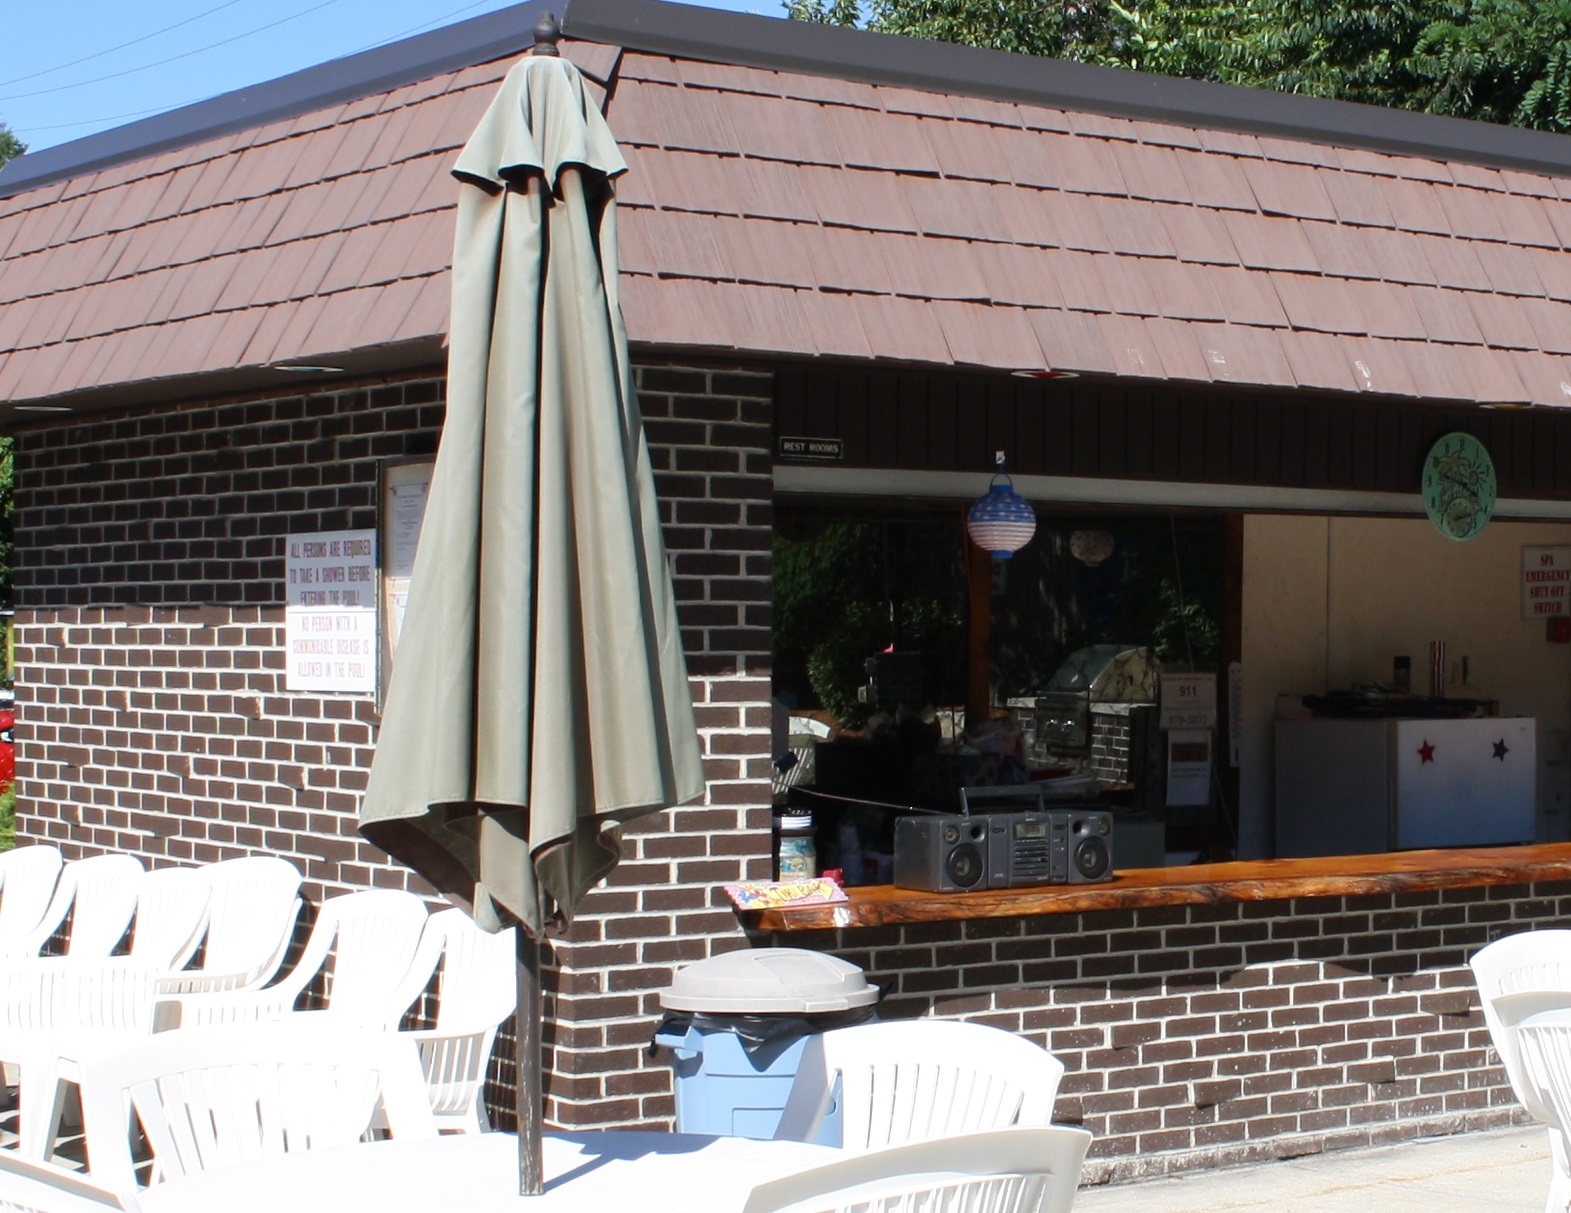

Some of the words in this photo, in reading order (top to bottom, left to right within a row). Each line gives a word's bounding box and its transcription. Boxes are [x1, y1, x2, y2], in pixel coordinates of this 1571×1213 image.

[783, 441, 805, 451] REST
[809, 443, 839, 453] ROOMS
[291, 543, 300, 558] ALL
[303, 542, 326, 558] PERSONS
[330, 541, 341, 557] ARE
[344, 540, 371, 559] REQUIRED
[1541, 554, 1554, 566] SPA
[289, 568, 297, 584] TO
[300, 567, 313, 583] TAKE
[322, 566, 345, 583] SHOWER
[348, 565, 370, 582] BEFORE
[1526, 570, 1569, 582] EMERGENCY
[301, 590, 326, 606] ENTERING
[329, 590, 339, 605] THE
[1530, 586, 1549, 598] SHUT
[1551, 585, 1564, 597] OFF
[1533, 601, 1562, 613] SWITCH
[302, 616, 309, 632] NO
[312, 616, 333, 632] PERSON
[335, 616, 350, 632] WITH
[292, 639, 334, 655] COMMUNICABLE
[337, 639, 360, 655] DISEASE
[363, 640, 369, 655] IS
[298, 662, 322, 678] ALLOWED
[325, 662, 331, 678] IN
[334, 662, 345, 678] THE
[1179, 685, 1197, 697] 911
[771, 887, 797, 901] TIKI
[798, 881, 820, 898] BAR
